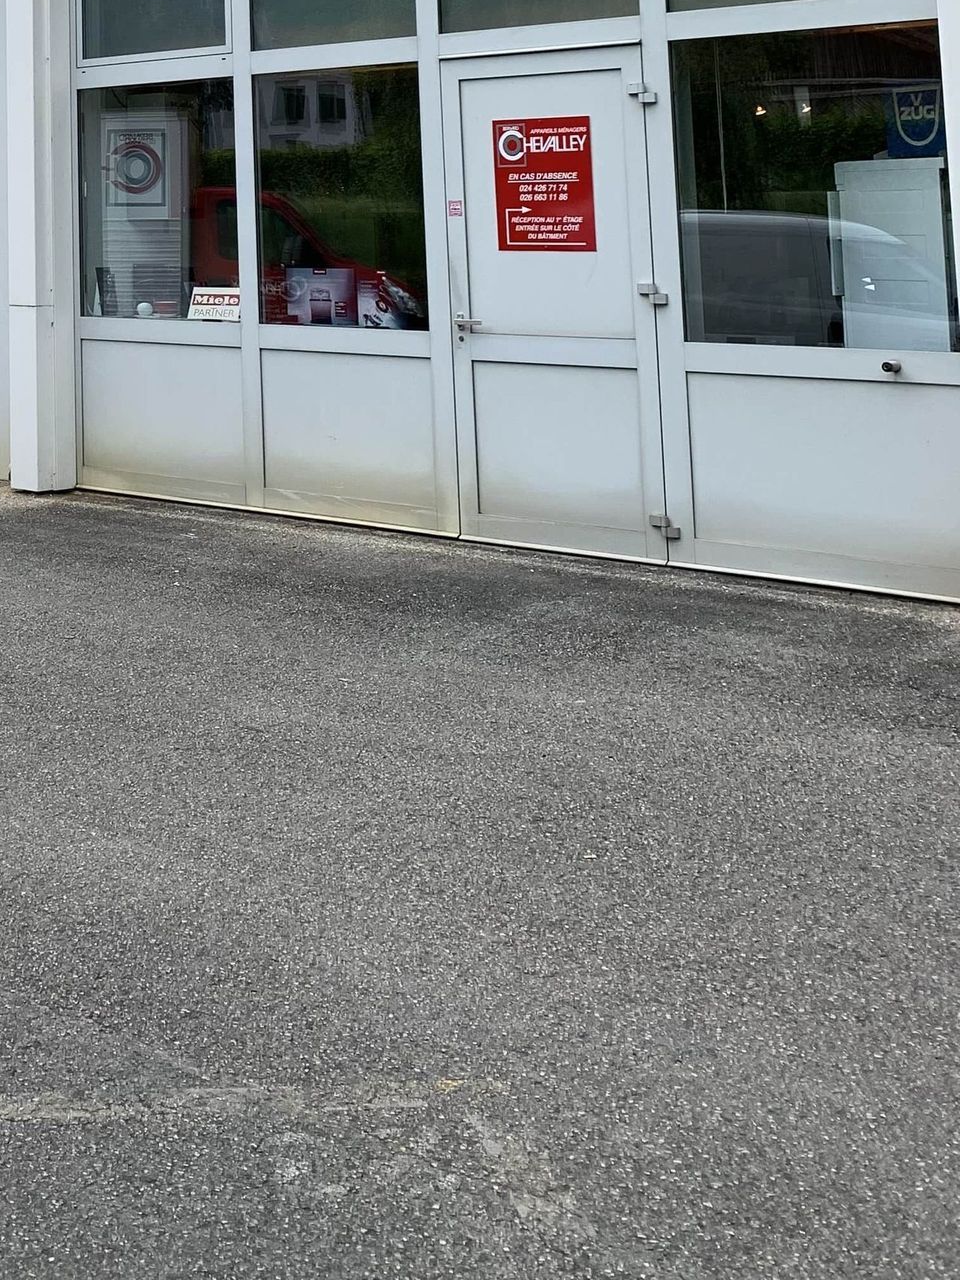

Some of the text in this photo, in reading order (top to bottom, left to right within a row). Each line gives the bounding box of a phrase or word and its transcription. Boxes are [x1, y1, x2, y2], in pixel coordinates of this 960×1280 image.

[910, 94, 924, 107] V
[899, 106, 936, 120] ZUG
[499, 130, 587, 161] CHEVALLEY
[519, 184, 532, 192] 024
[511, 215, 545, 223] RÉCEPTION
[563, 215, 584, 223] ÉTAGE
[193, 295, 239, 305] Miele
[193, 307, 234, 318] PARTNER
